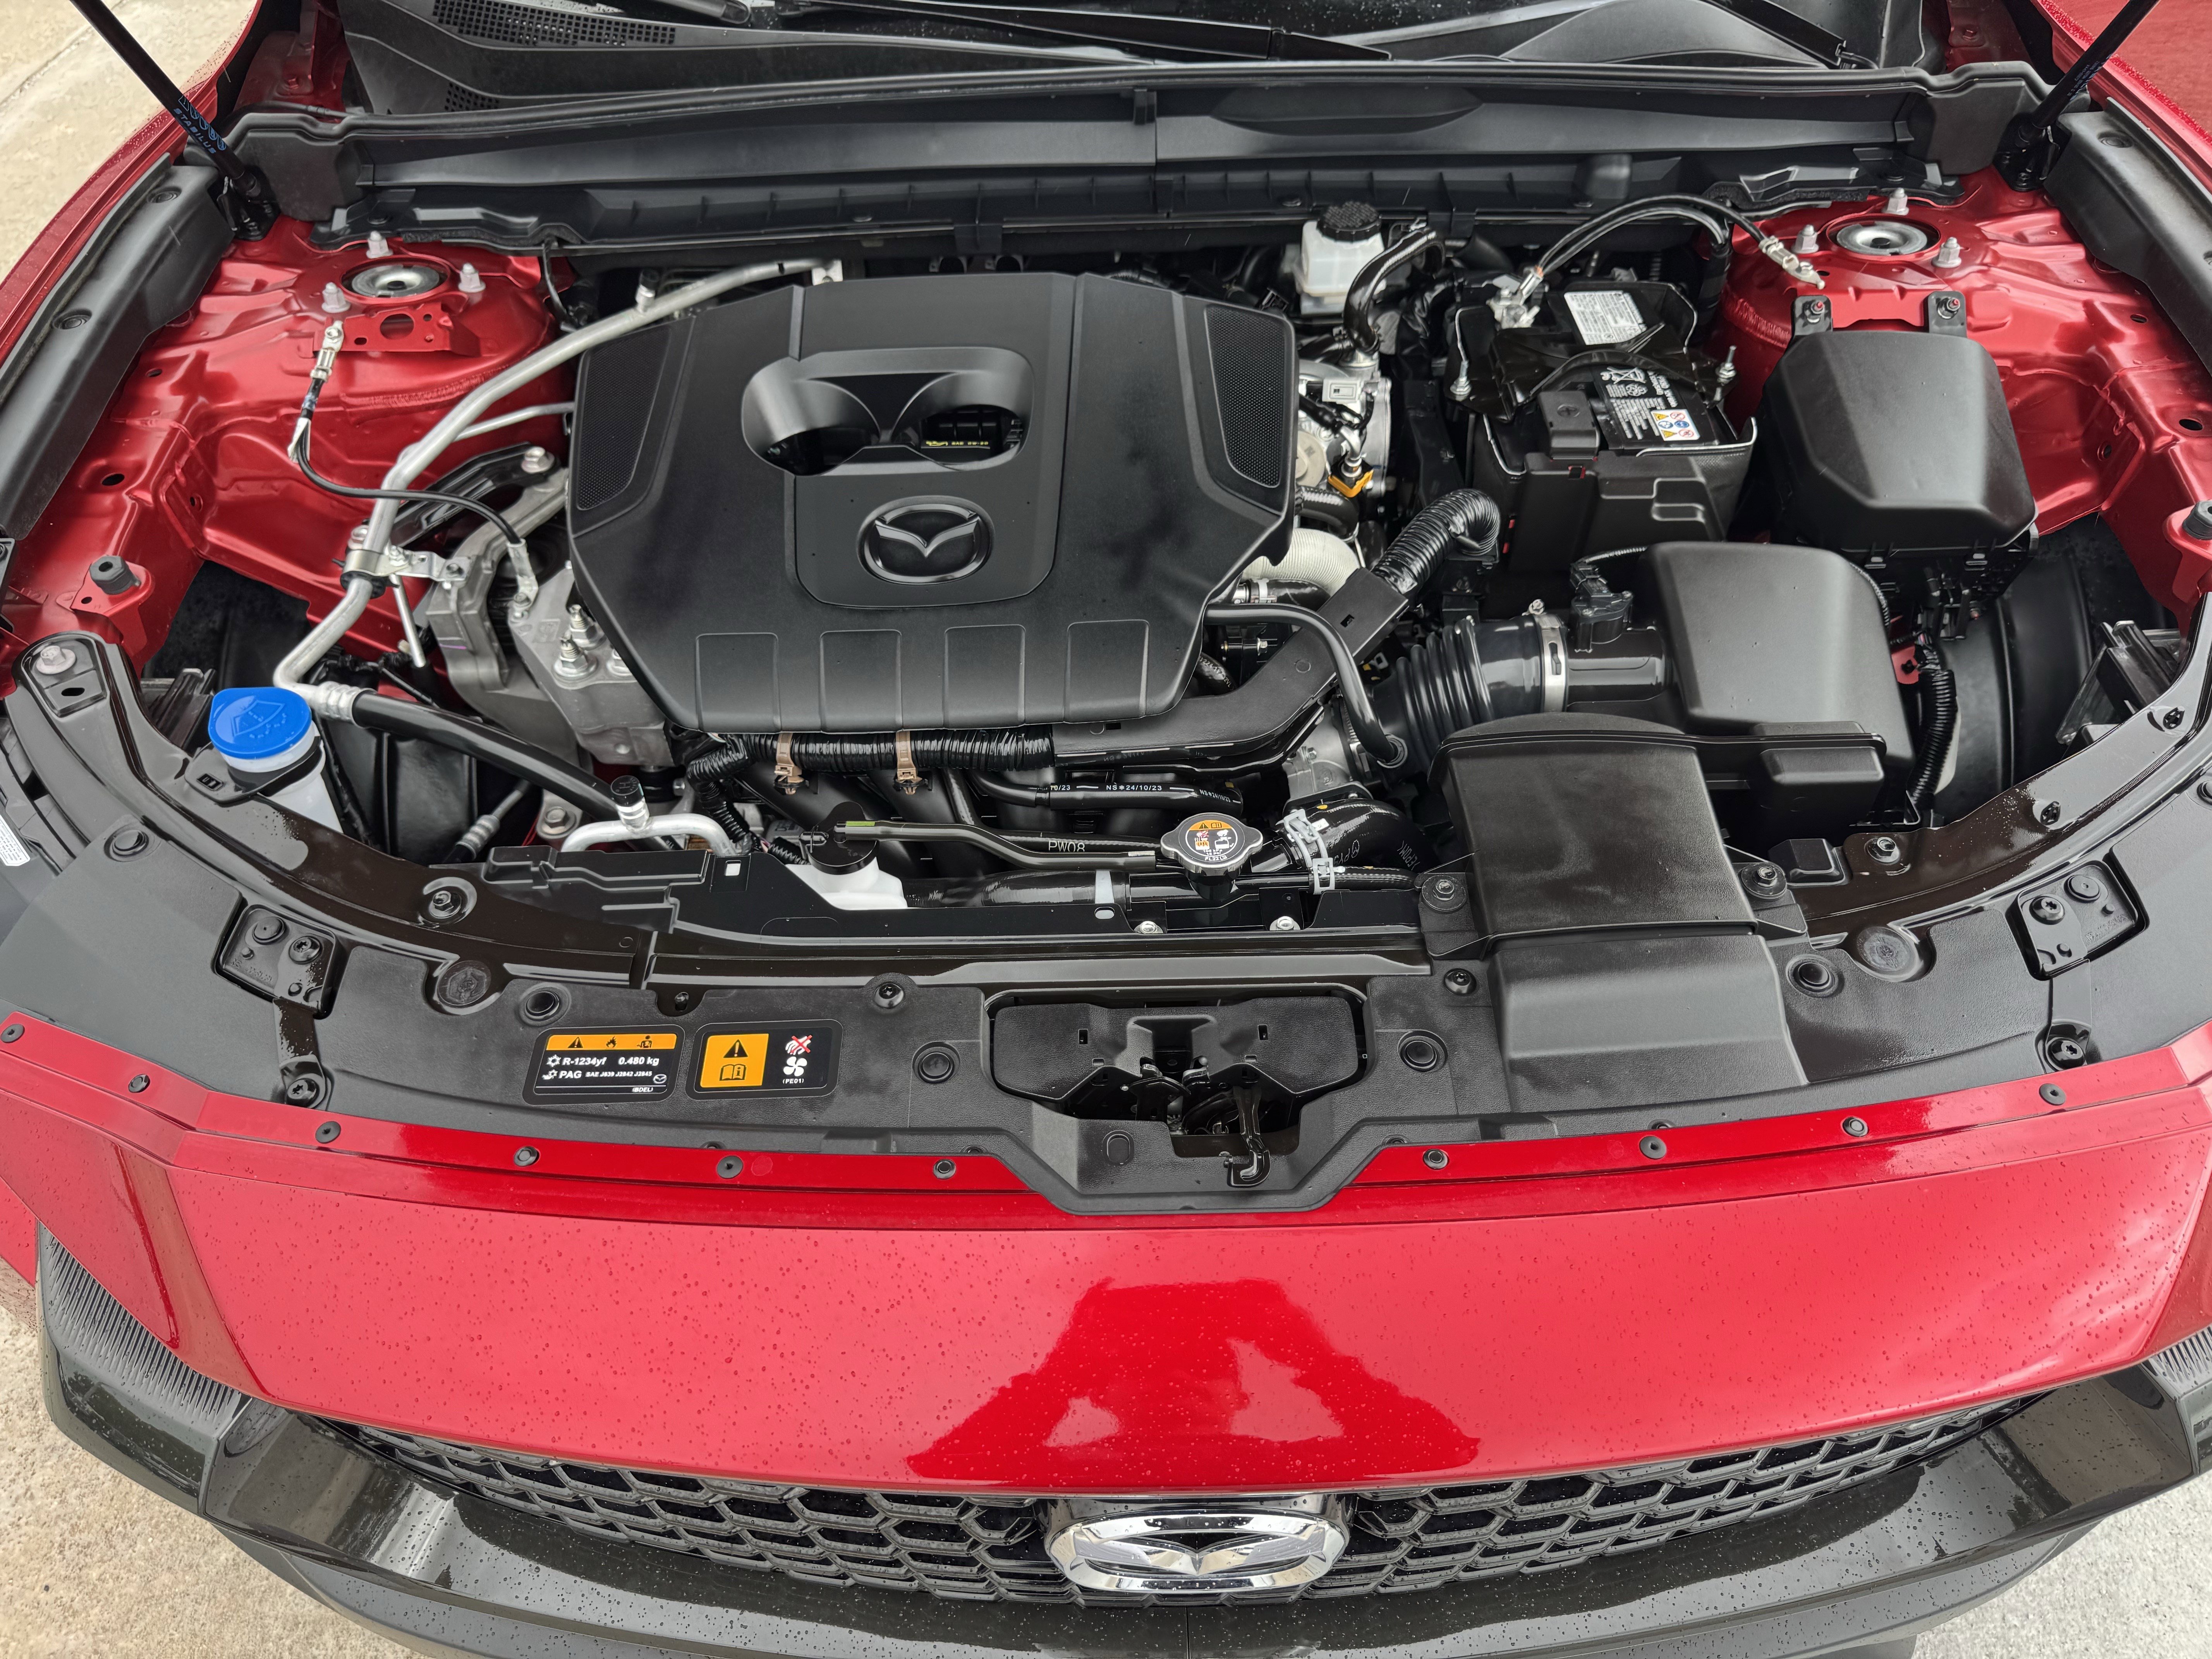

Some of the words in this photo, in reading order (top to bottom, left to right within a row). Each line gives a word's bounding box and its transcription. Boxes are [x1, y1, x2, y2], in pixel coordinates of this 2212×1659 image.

[173, 108, 217, 154] STABILUS
[563, 1057, 607, 1067] R-1234yf
[618, 1056, 645, 1065] 0.480
[646, 1056, 659, 1066] kg
[559, 1071, 582, 1079] PAG
